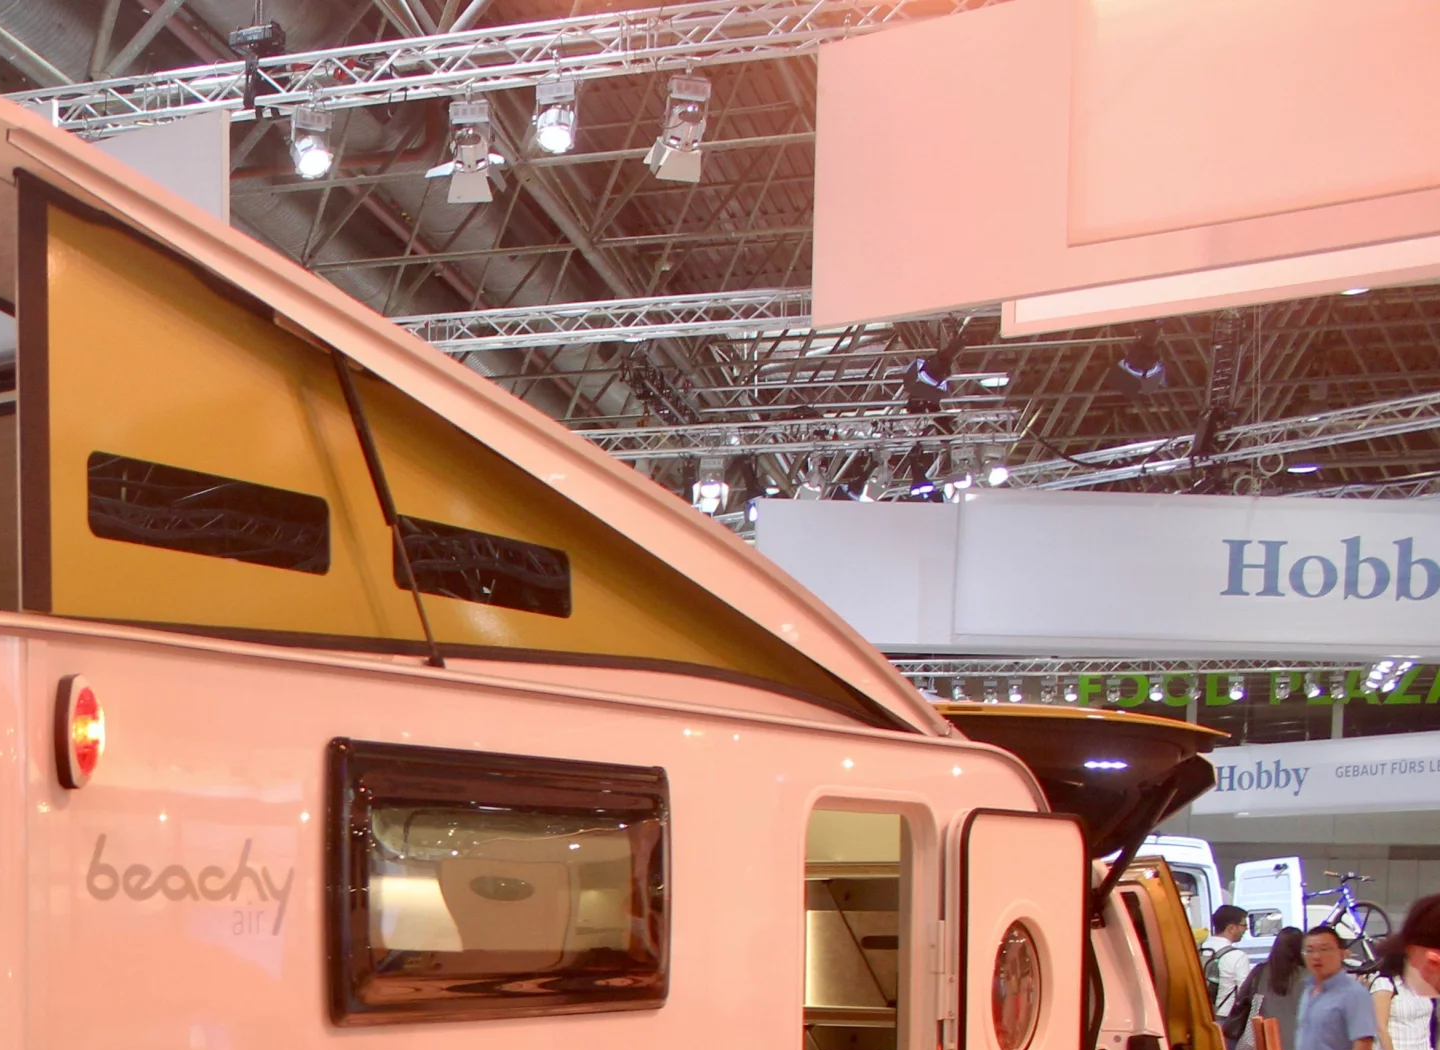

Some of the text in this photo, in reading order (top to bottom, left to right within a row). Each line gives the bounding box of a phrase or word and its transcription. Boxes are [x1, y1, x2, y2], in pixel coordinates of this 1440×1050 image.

[1220, 535, 1440, 601] Hobb
[1078, 672, 1242, 707] FOOD
[1215, 759, 1309, 796] Hobby
[1335, 762, 1387, 778] GEBAUT
[1391, 759, 1425, 775] FÜRS
[86, 833, 295, 936] beachy
[232, 901, 264, 936] air
